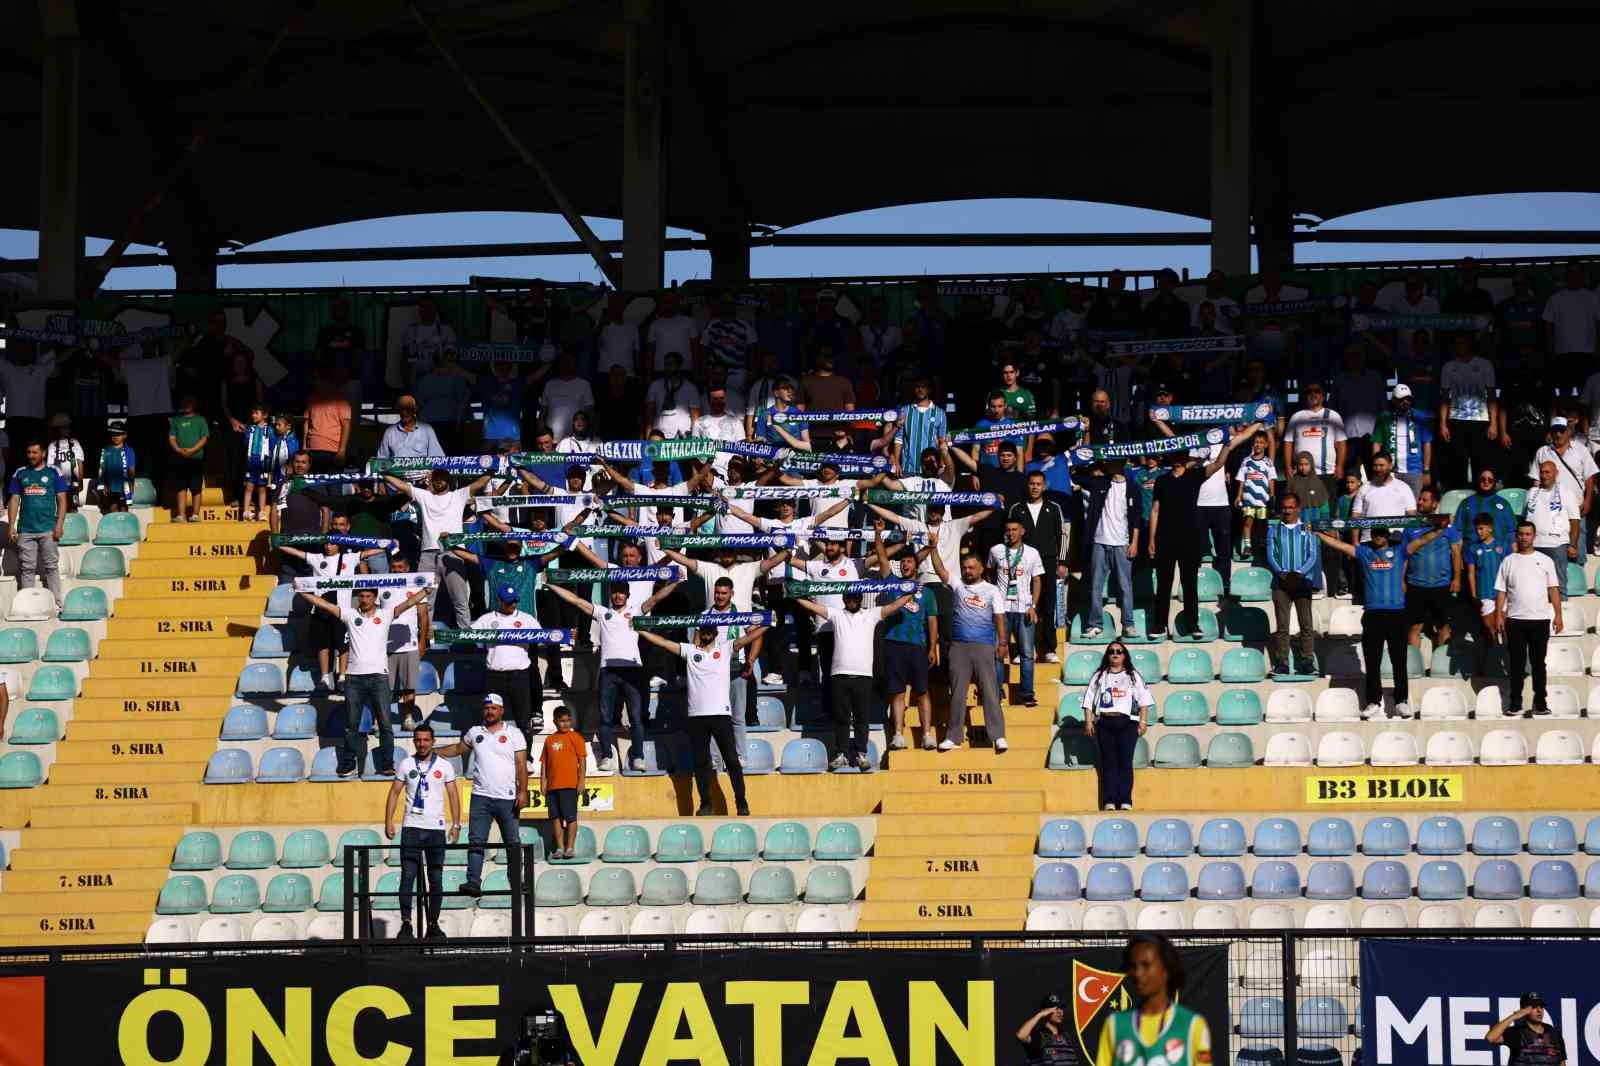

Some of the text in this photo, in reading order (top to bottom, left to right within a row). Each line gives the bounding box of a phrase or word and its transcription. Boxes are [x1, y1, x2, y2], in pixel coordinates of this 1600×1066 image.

[203, 510, 220, 520] 15.
[189, 545, 244, 556] 14. SIRA
[172, 580, 226, 591] 13. SIRA
[157, 621, 213, 633] 12. SIRA
[140, 661, 197, 673] 11. SIRA
[123, 701, 181, 712] 10. SIRA
[111, 743, 164, 755] 9. SIRA
[940, 773, 993, 785] 8. SIRA
[95, 788, 149, 800] 8. SIRA
[1318, 778, 1451, 799] B3 BLOK
[926, 860, 980, 872] 7. SIRA
[60, 875, 113, 887] 7. SIRA
[918, 905, 973, 917] 6. SIRA
[39, 918, 95, 930] 6. SIRA
[117, 968, 996, 1066] ÖNCE VATAN
